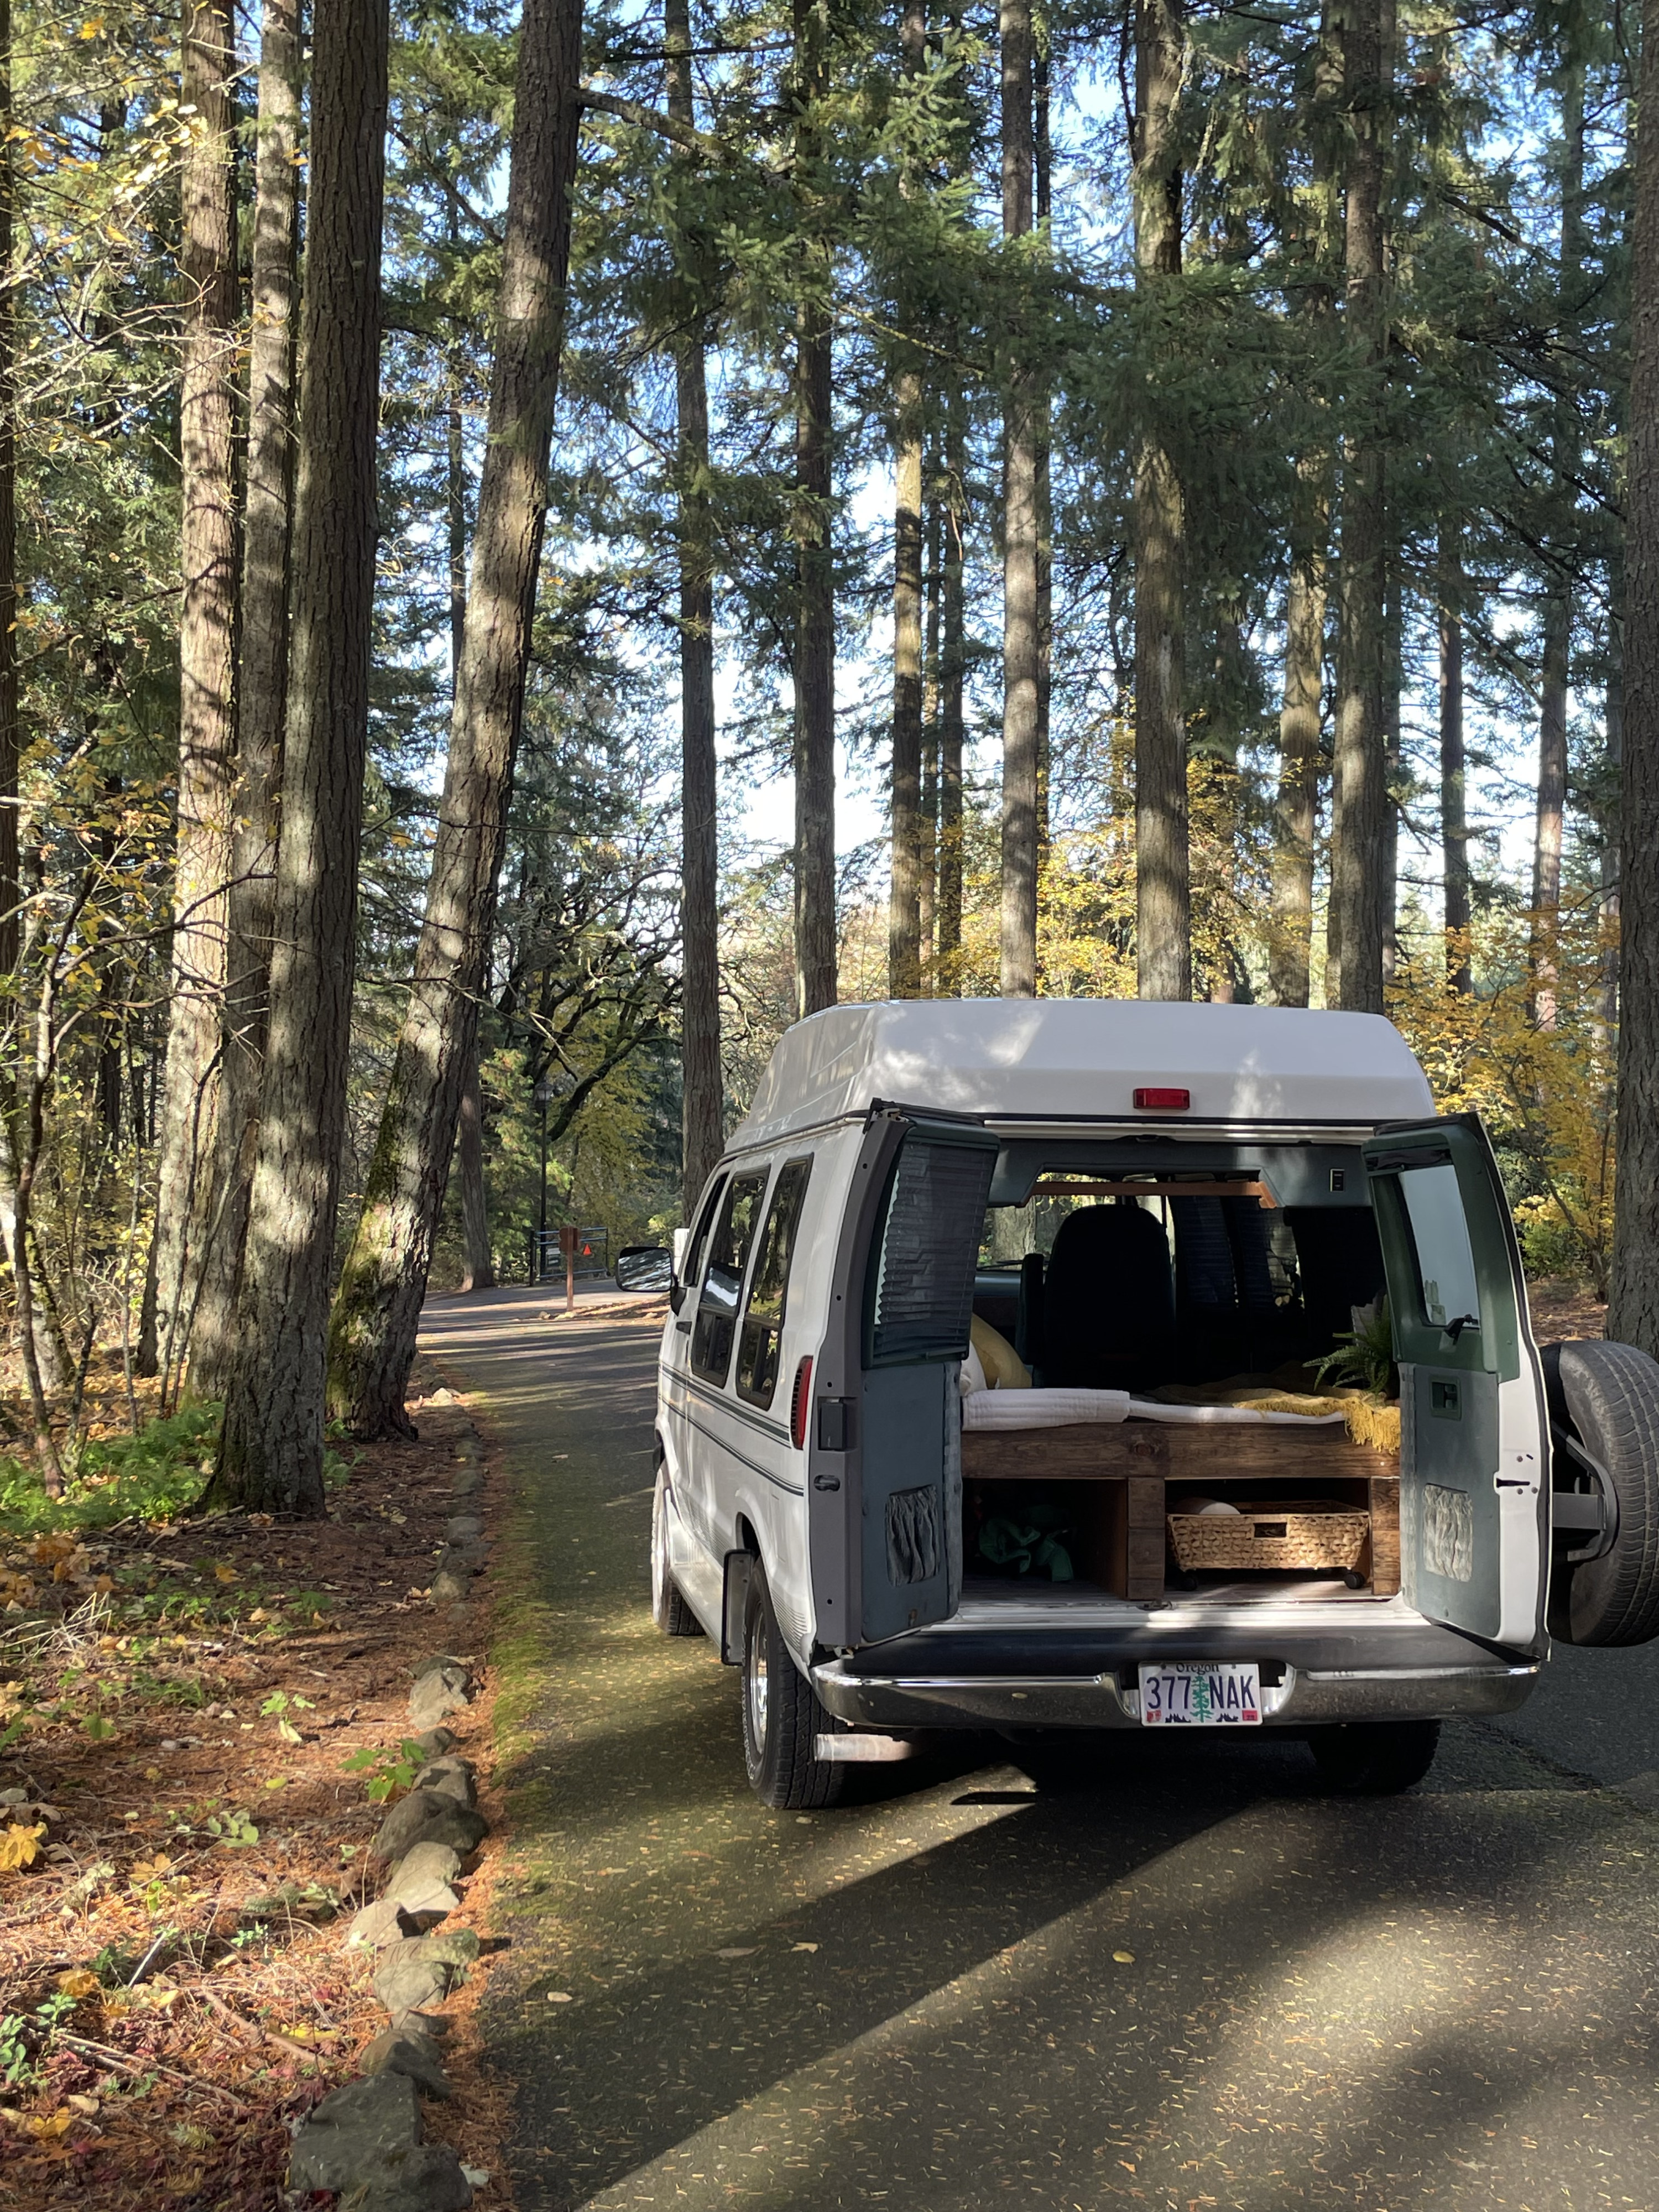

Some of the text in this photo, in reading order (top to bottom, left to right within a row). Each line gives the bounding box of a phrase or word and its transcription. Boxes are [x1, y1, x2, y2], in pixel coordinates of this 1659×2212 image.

[1176, 1662, 1219, 1675] Oregon
[1146, 1676, 1255, 1709] 377 NAK
